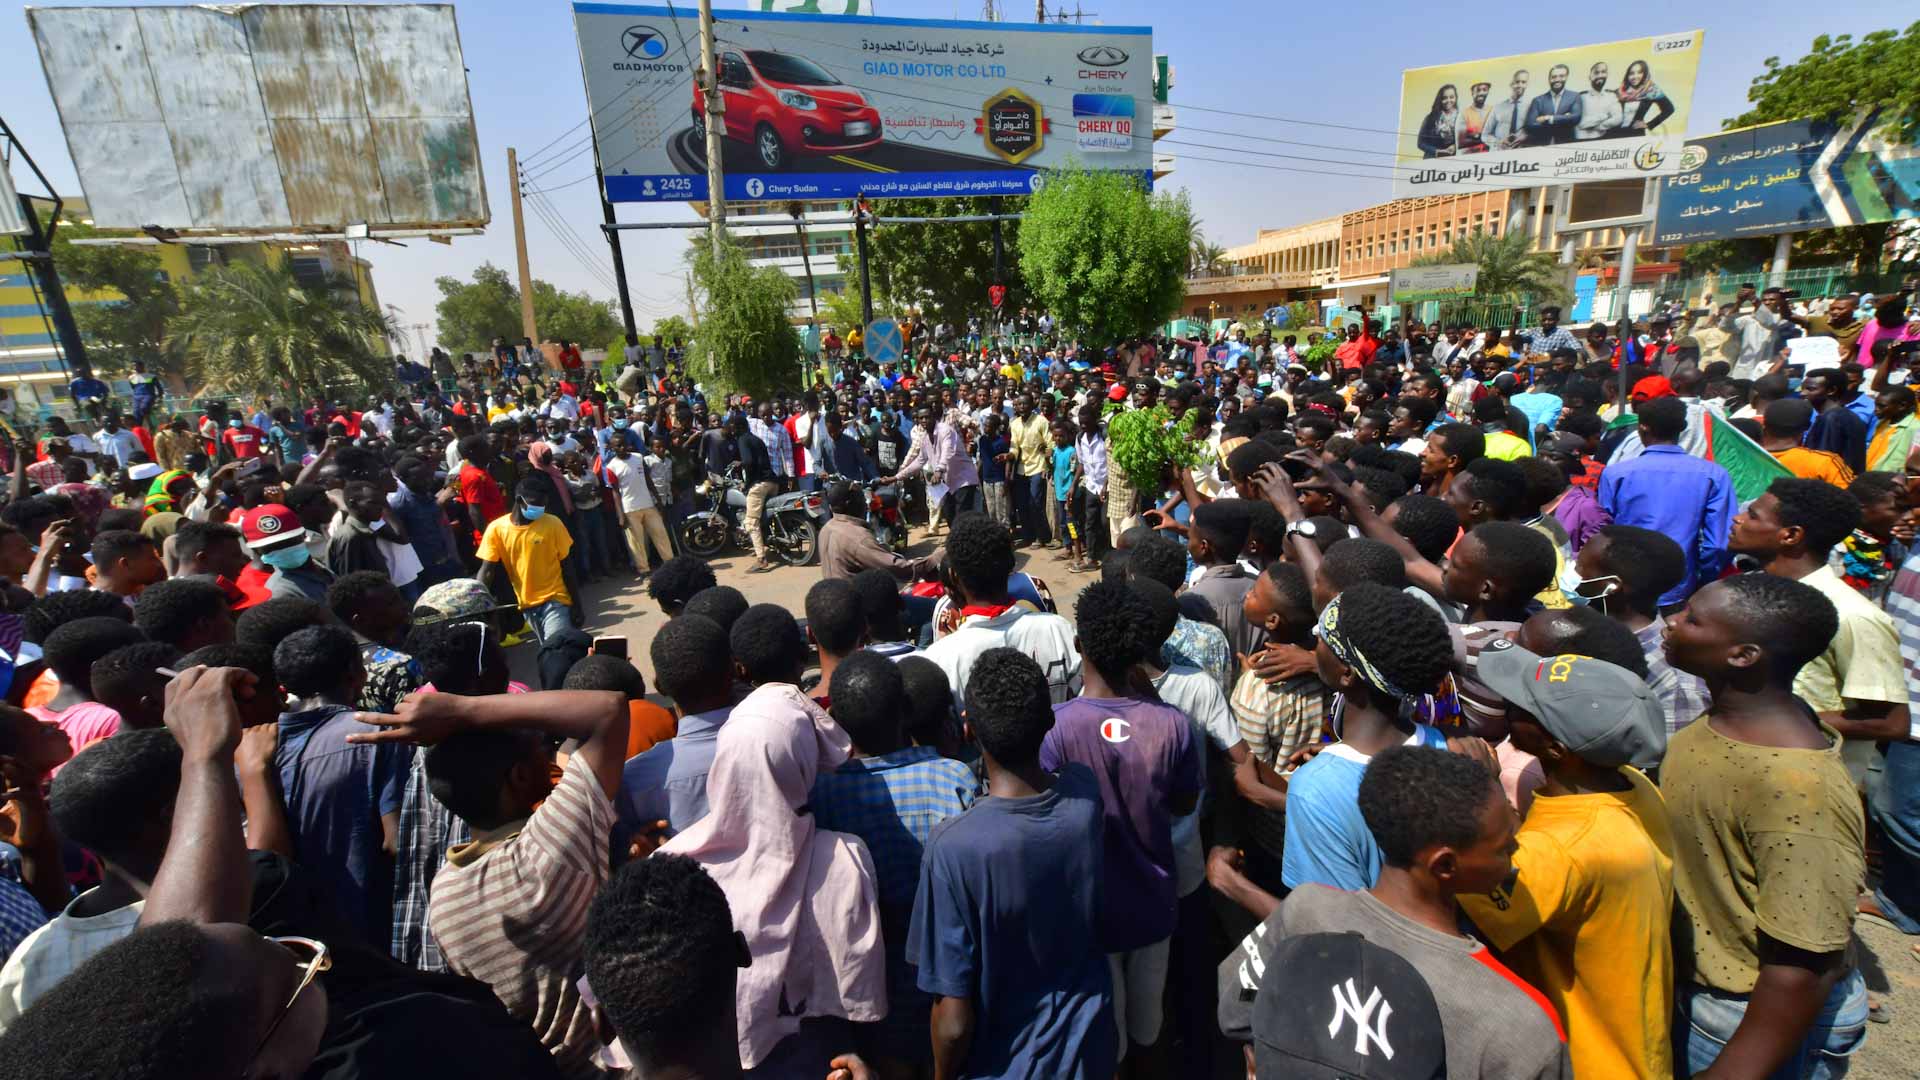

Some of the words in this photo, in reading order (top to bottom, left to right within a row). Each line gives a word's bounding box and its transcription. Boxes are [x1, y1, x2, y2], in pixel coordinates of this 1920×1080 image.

[862, 39, 905, 54] المحدودة
[908, 40, 948, 55] للسيارات
[951, 42, 975, 56] جياد
[976, 42, 1005, 57] شركة
[1666, 39, 1691, 49] 2227
[612, 63, 641, 71] GIAD
[643, 64, 684, 72] MOTOR
[864, 62, 898, 76] GIAD
[902, 63, 954, 77] MOTOR
[1078, 70, 1128, 80] CHERY
[1078, 120, 1112, 133] CHERY
[1116, 121, 1130, 134] QQ
[1489, 160, 1540, 176] عمالك
[1409, 169, 1447, 184] مالك
[1668, 173, 1702, 187] FCB
[1734, 175, 1759, 191] ناس
[1764, 167, 1801, 187] تطبيق
[660, 178, 692, 191] 2425
[768, 184, 792, 193] Chery
[793, 184, 818, 193] Sudan
[881, 182, 898, 193] شارع
[970, 180, 997, 191] الخرطوم
[1699, 178, 1730, 193] البيت
[1680, 205, 1722, 218] حياتك
[1328, 977, 1395, 1061] NY
